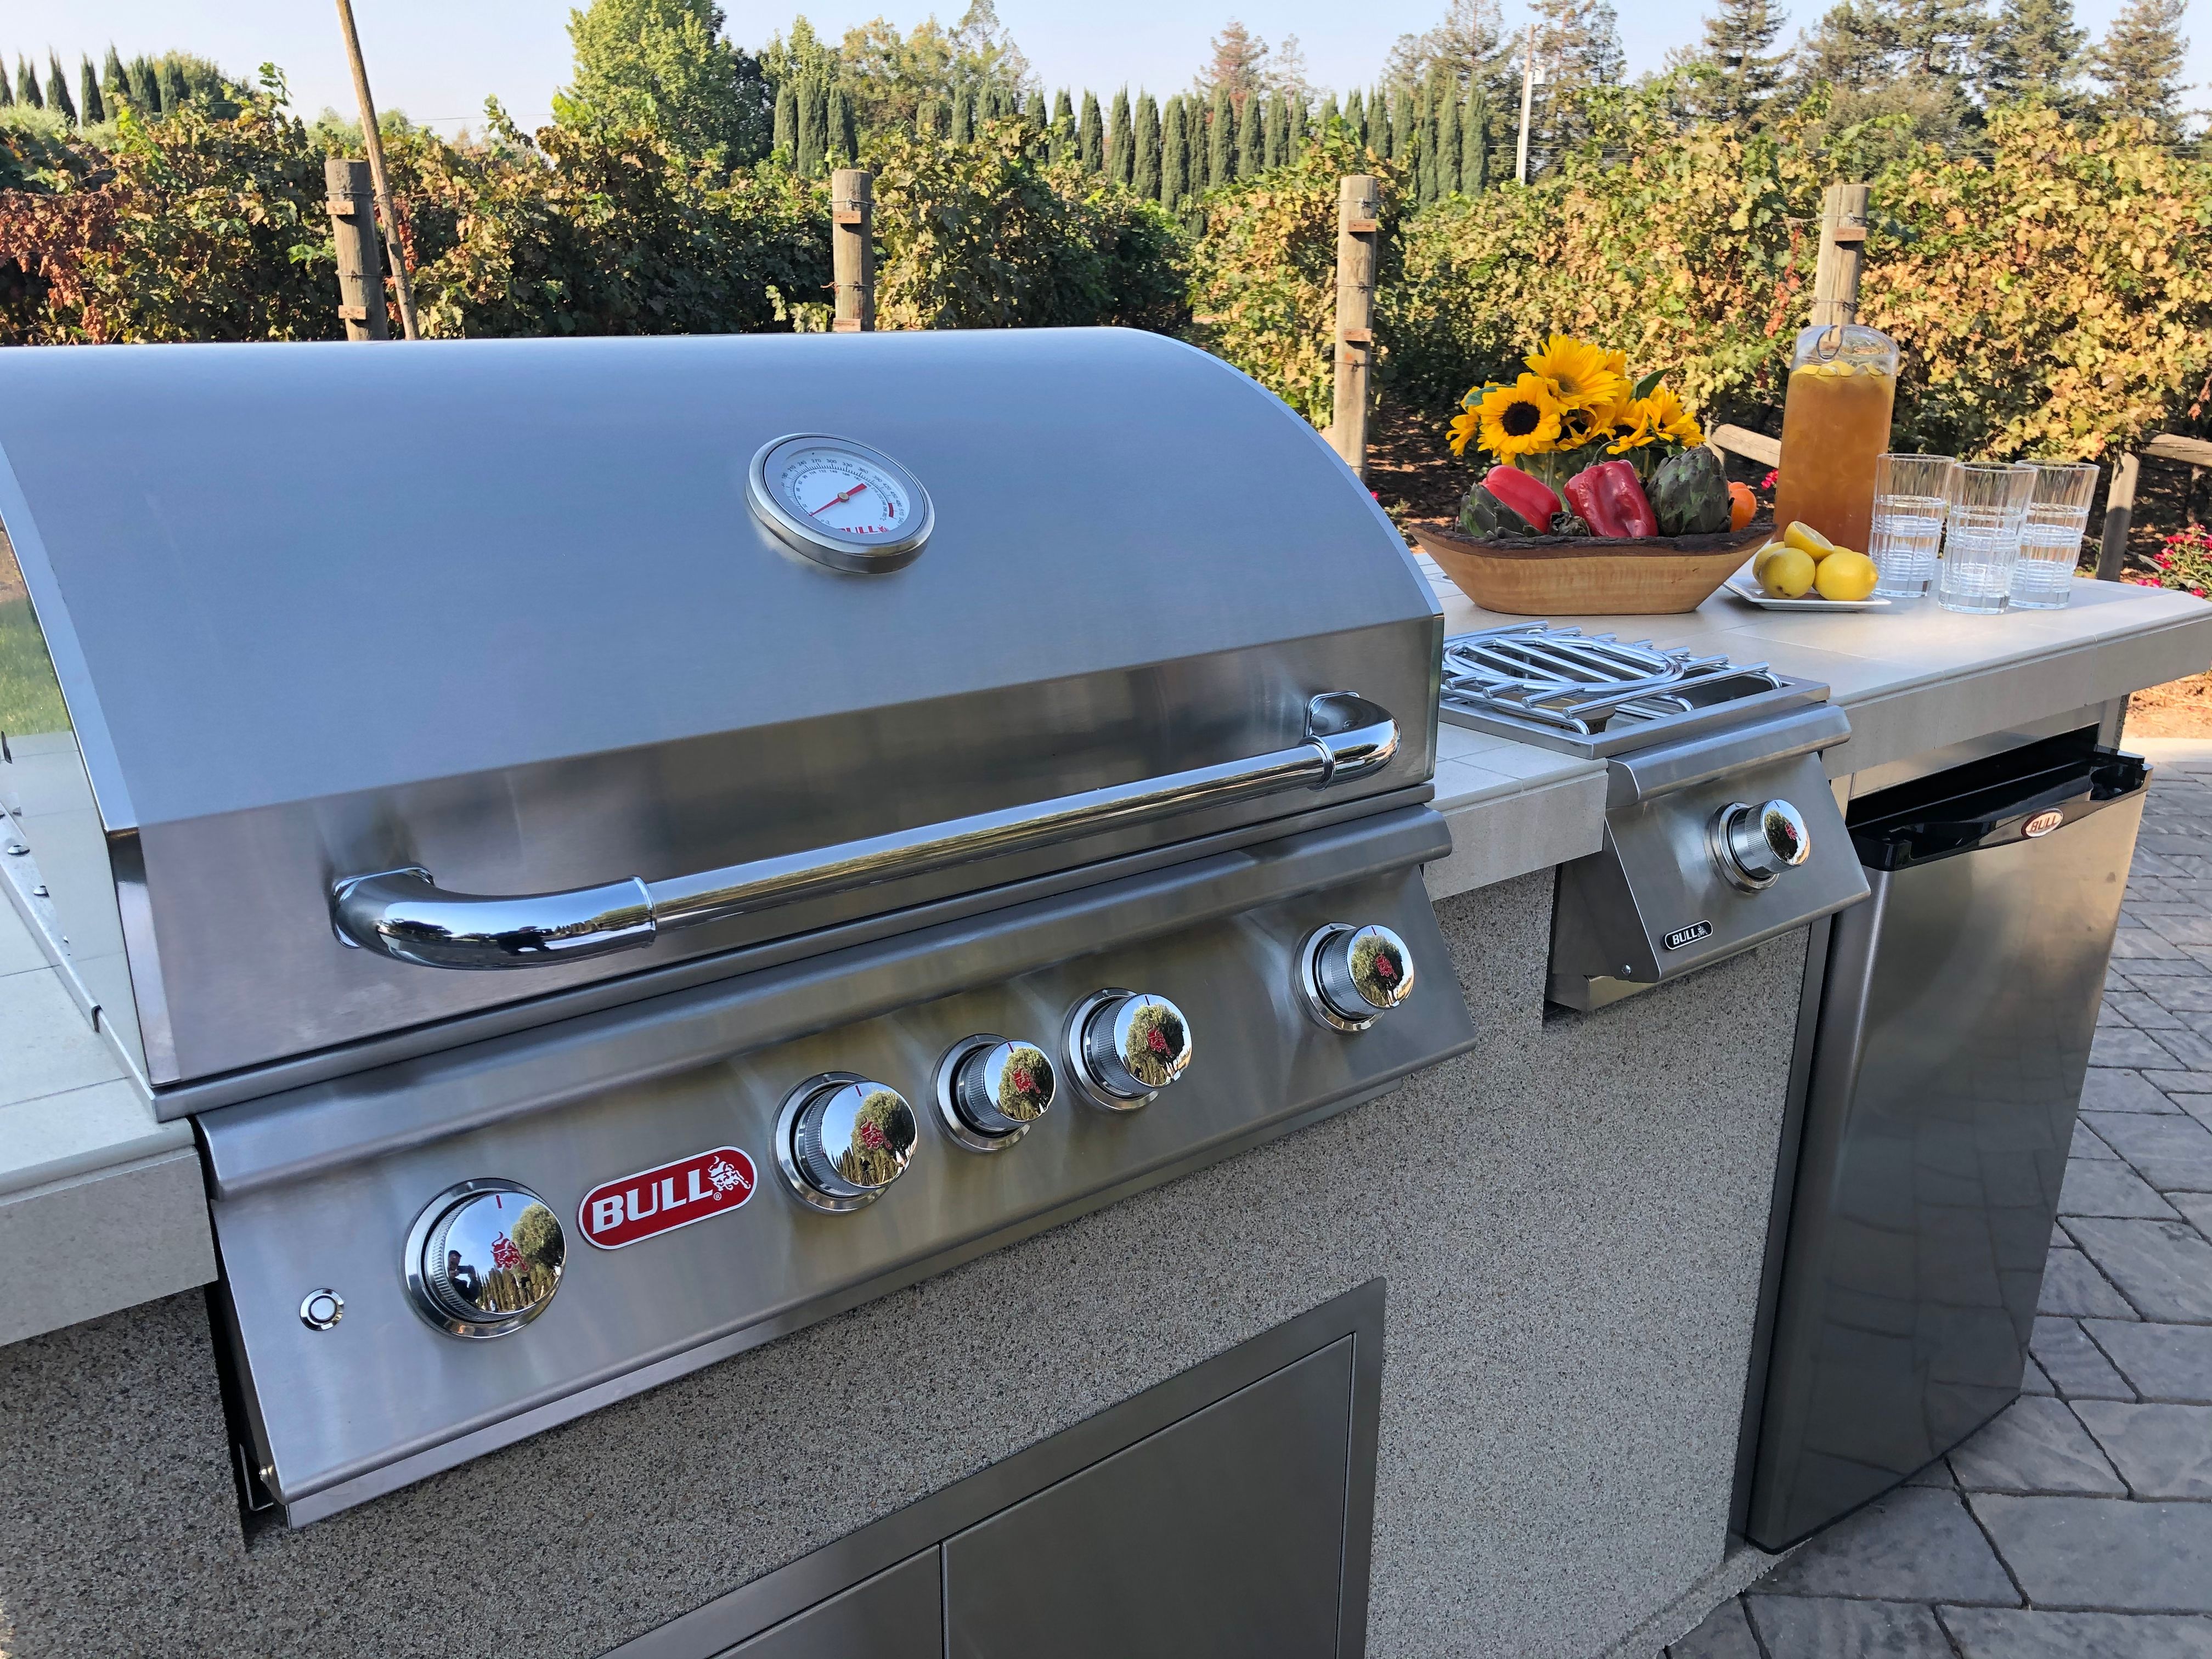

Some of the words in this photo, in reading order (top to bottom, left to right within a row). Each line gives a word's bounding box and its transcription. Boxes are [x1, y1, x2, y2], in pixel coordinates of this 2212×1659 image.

[839, 526, 878, 534] ULL
[2030, 815, 2057, 832] BULL
[1672, 928, 1697, 945] BULL
[592, 1169, 713, 1234] BULL
